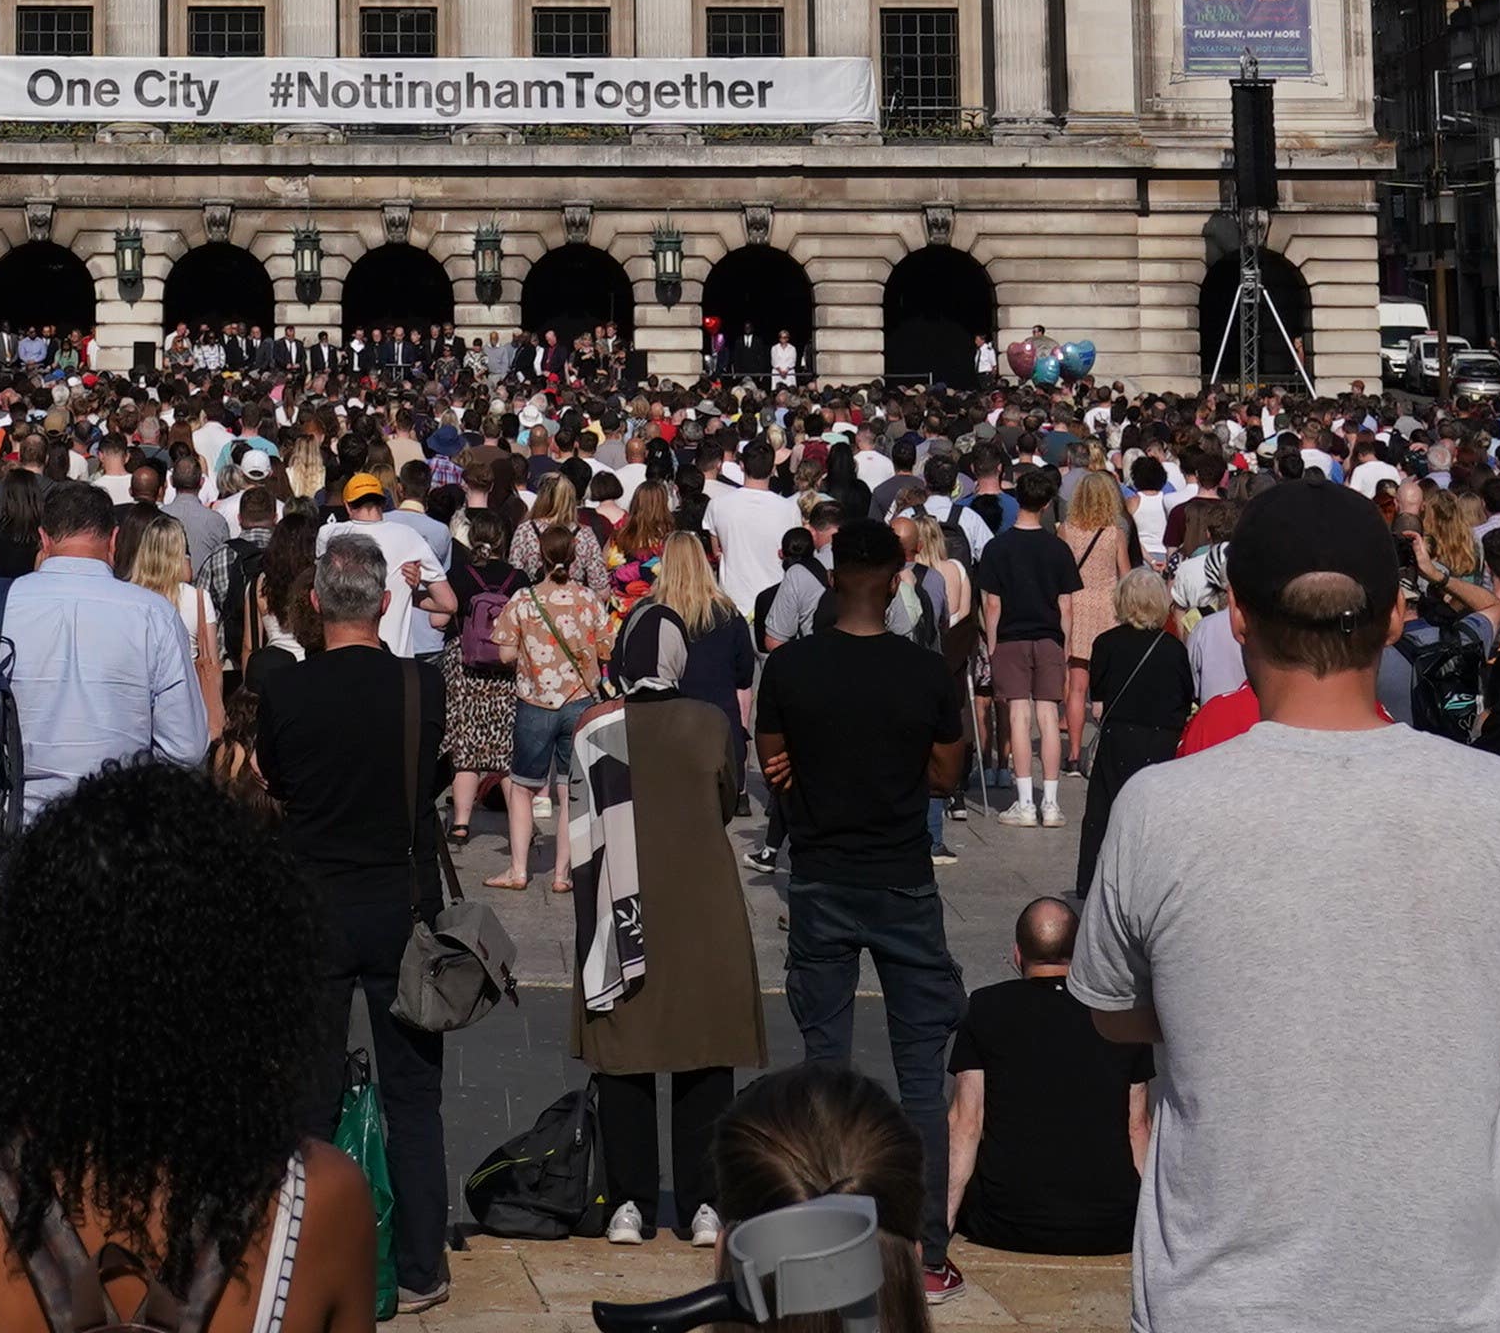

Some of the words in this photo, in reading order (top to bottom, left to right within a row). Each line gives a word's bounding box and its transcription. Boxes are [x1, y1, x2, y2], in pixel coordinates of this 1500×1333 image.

[1194, 30, 1216, 39] PLUS
[1217, 30, 1246, 39] MANY,
[1247, 30, 1273, 38] MANY
[1274, 30, 1300, 39] MORE
[27, 69, 119, 110] One
[134, 68, 219, 117] City
[269, 67, 774, 118] #NottinghamTogether
